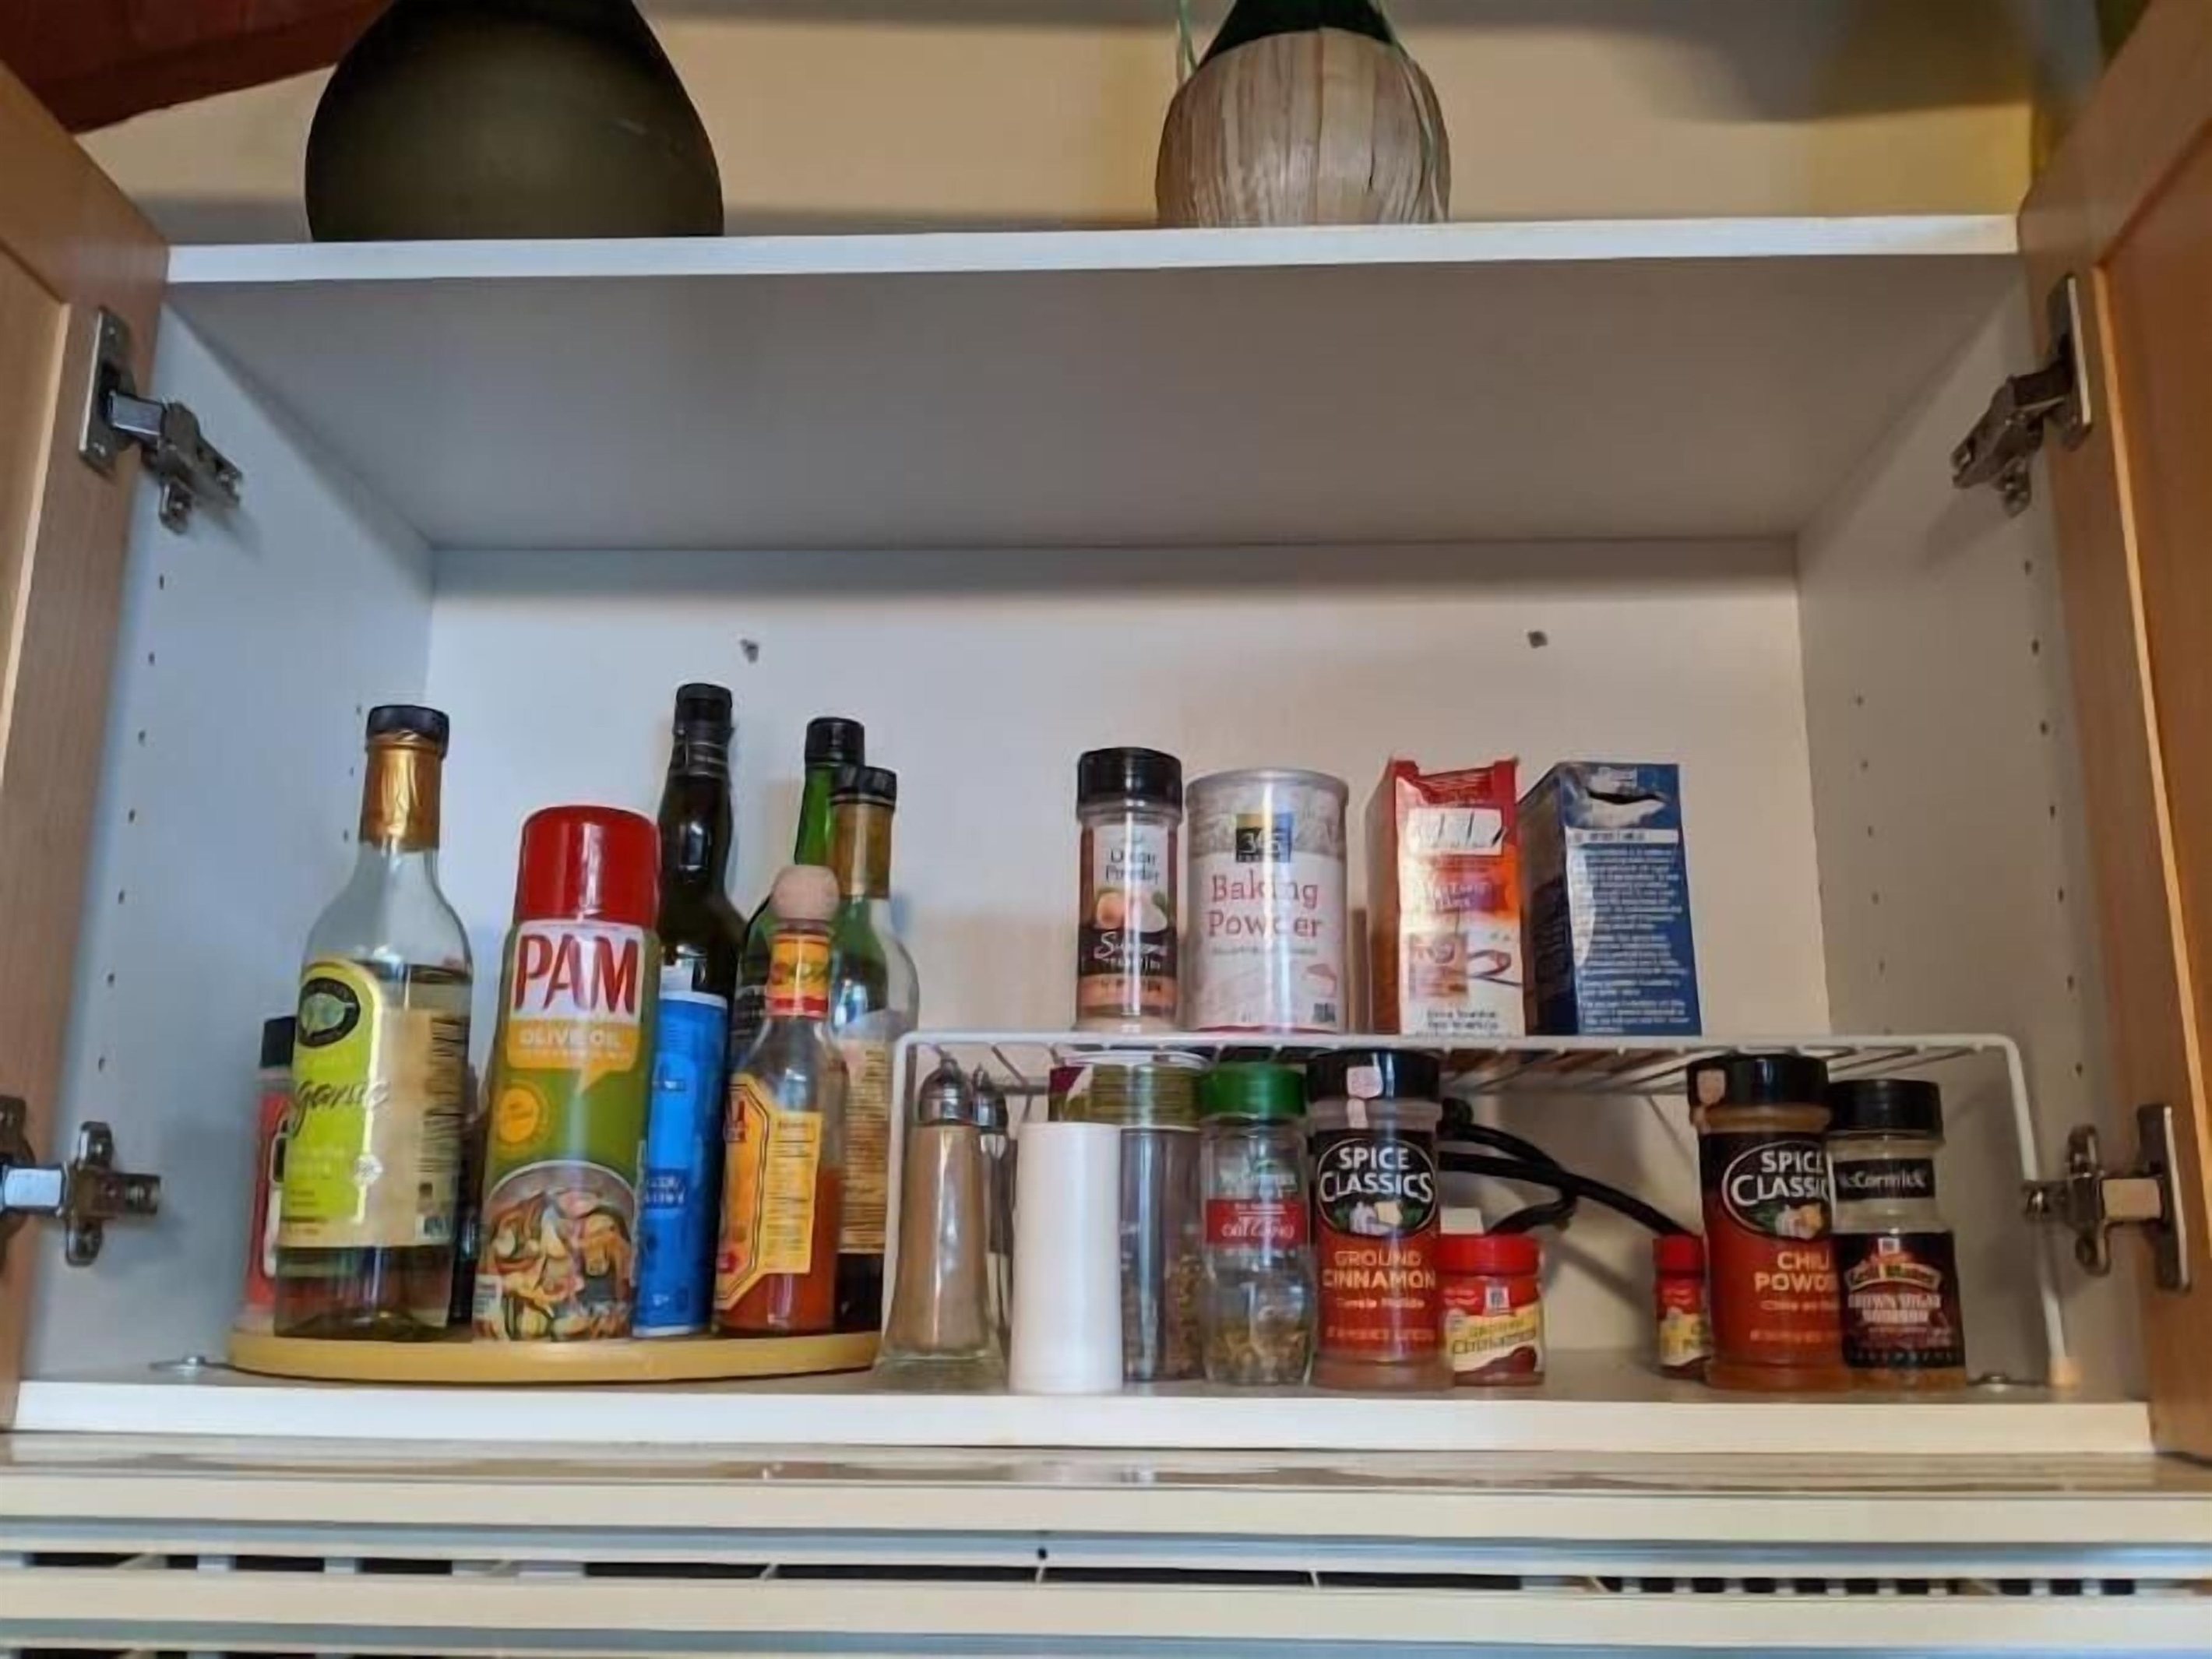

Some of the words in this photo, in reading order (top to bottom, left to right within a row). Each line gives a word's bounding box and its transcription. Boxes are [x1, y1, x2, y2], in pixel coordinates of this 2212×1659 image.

[1105, 865, 1159, 883] Poder
[1211, 871, 1319, 909] Baking
[1207, 910, 1323, 938] Powder
[515, 934, 639, 1014] PAM
[520, 1028, 583, 1048] OLIVE
[589, 1030, 622, 1048] OIL
[1339, 1147, 1411, 1169] SPICE
[1320, 1171, 1434, 1203] CLASSICS
[1334, 1249, 1422, 1267] GROUND
[1322, 1270, 1437, 1290] CINNAMON
